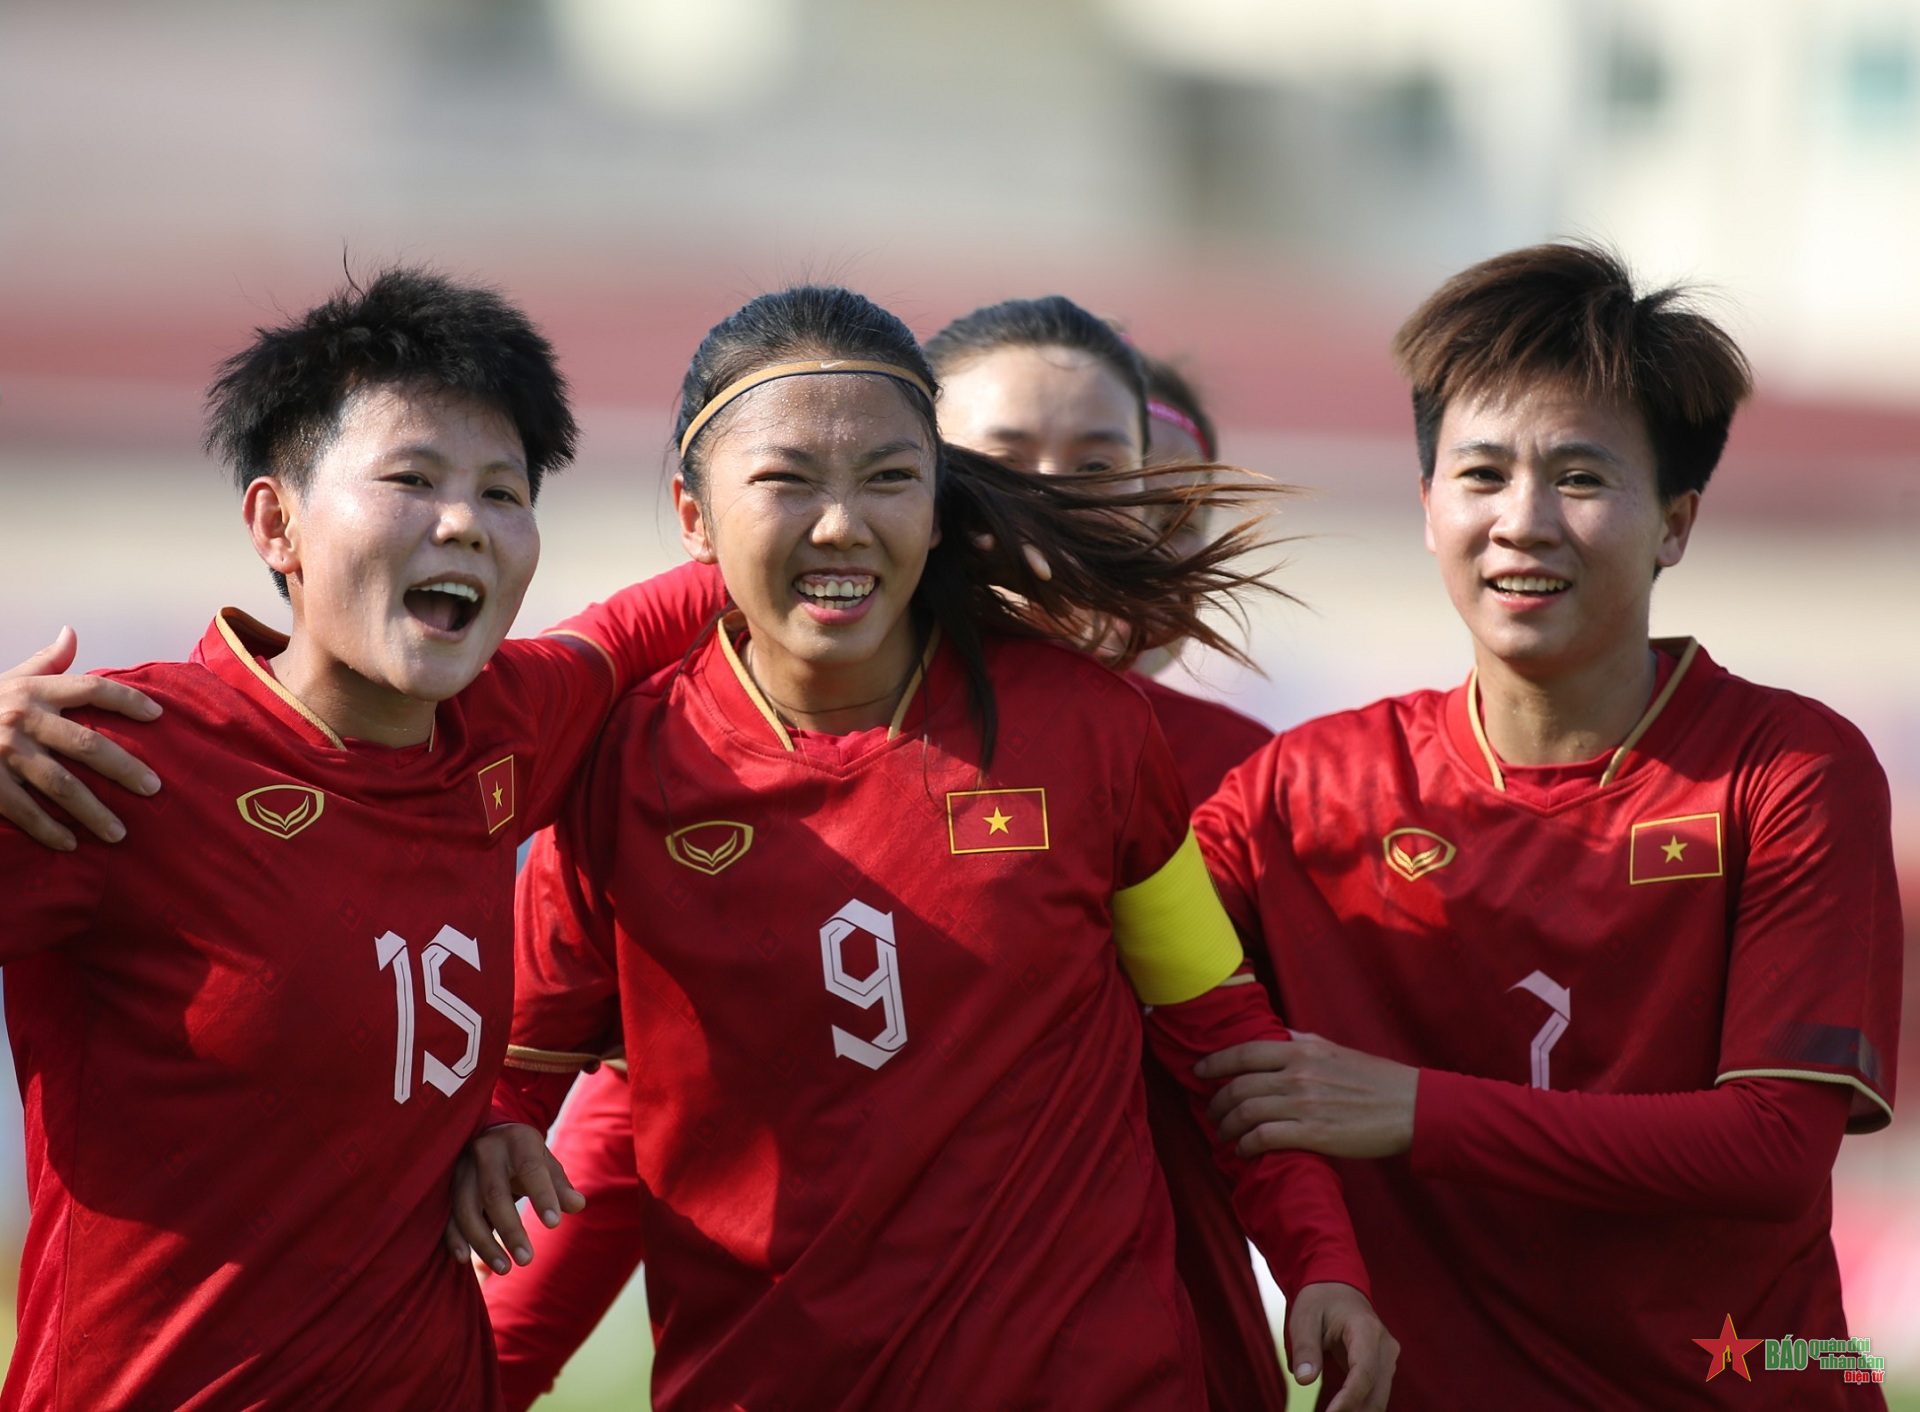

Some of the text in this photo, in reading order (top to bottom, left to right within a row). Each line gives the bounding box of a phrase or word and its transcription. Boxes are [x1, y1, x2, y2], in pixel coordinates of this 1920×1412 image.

[374, 924, 482, 1105] 15
[819, 898, 908, 1071] 9
[1505, 969, 1571, 1091] 7
